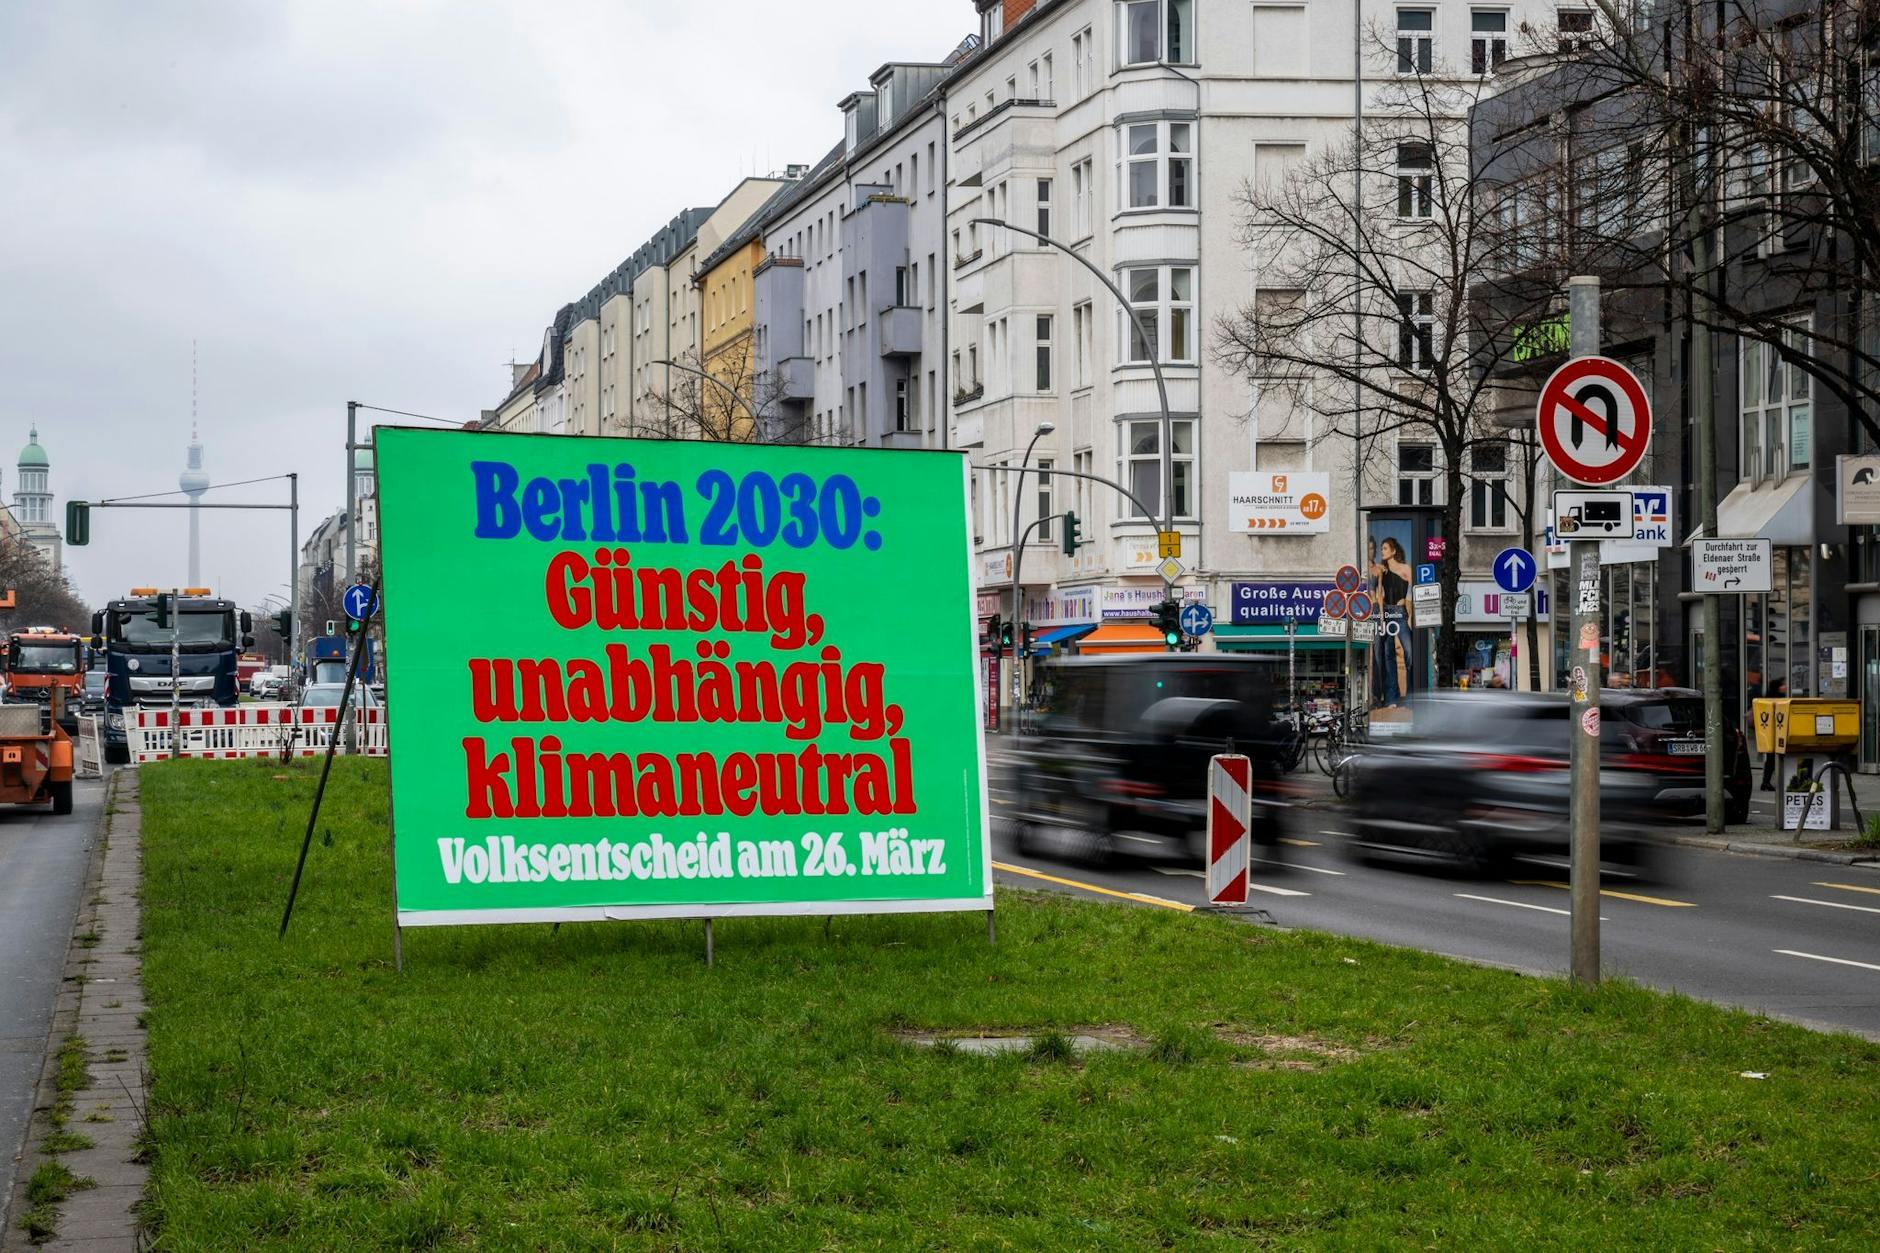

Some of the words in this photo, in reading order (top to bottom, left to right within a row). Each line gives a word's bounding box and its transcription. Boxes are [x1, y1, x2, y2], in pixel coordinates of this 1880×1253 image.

[470, 460, 688, 545] Berlin
[696, 468, 882, 551] 2030:
[1233, 496, 1293, 504] HAARSCHNITT
[1308, 499, 1319, 512] 17
[1636, 524, 1667, 540] ank
[1167, 547, 1173, 555] 5
[1705, 542, 1743, 552] Durchfahrt
[1746, 543, 1758, 551] zur
[1703, 553, 1734, 563] Eldenaer
[1737, 553, 1761, 562] Straße
[1421, 567, 1431, 582] P
[1717, 565, 1748, 575] gesperrt
[545, 547, 824, 650] Günstig,
[1240, 587, 1287, 599] Große
[1240, 603, 1315, 620] qualitativ
[469, 639, 904, 740] unabhängig,
[462, 735, 917, 818] klimaneutral
[437, 831, 733, 884] Volksentscheid
[737, 840, 797, 878] am
[800, 832, 856, 878] 26.
[860, 828, 946, 876] März
